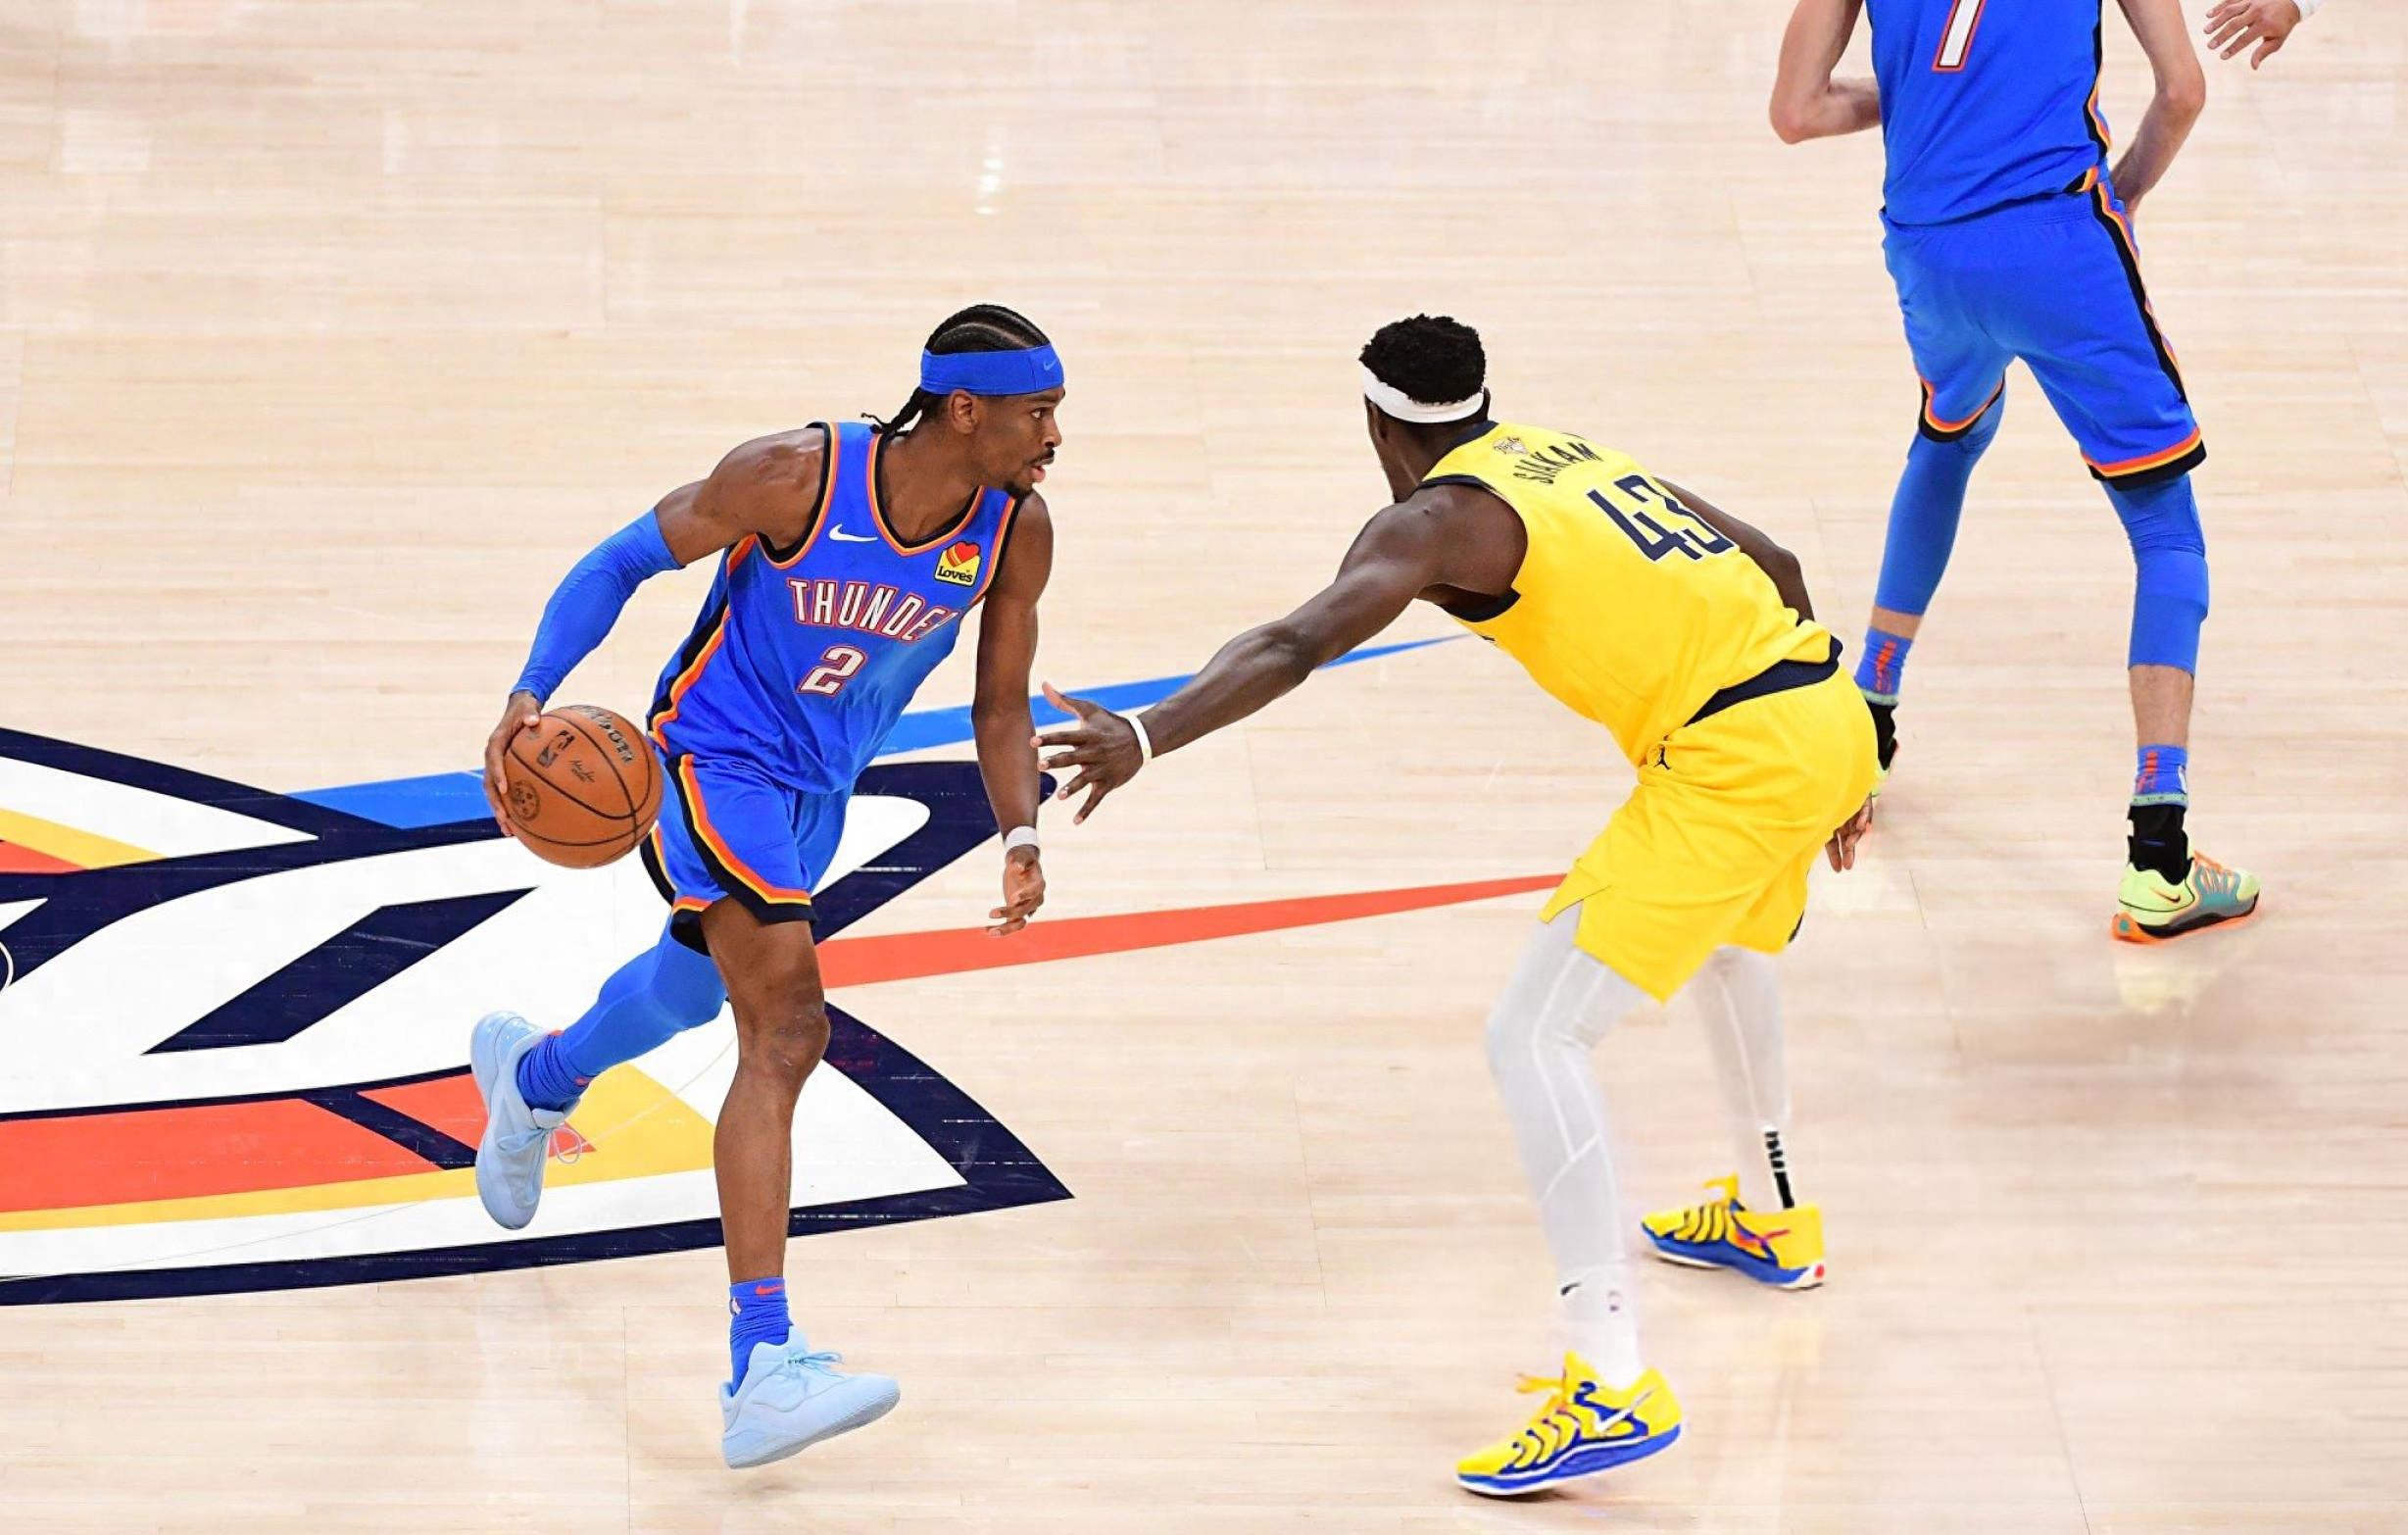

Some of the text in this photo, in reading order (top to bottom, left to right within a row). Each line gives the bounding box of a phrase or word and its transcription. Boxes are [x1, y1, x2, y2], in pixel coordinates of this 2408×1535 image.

[1584, 473, 1739, 563] 43
[787, 577, 960, 643] THUNDE
[797, 644, 867, 697] 2
